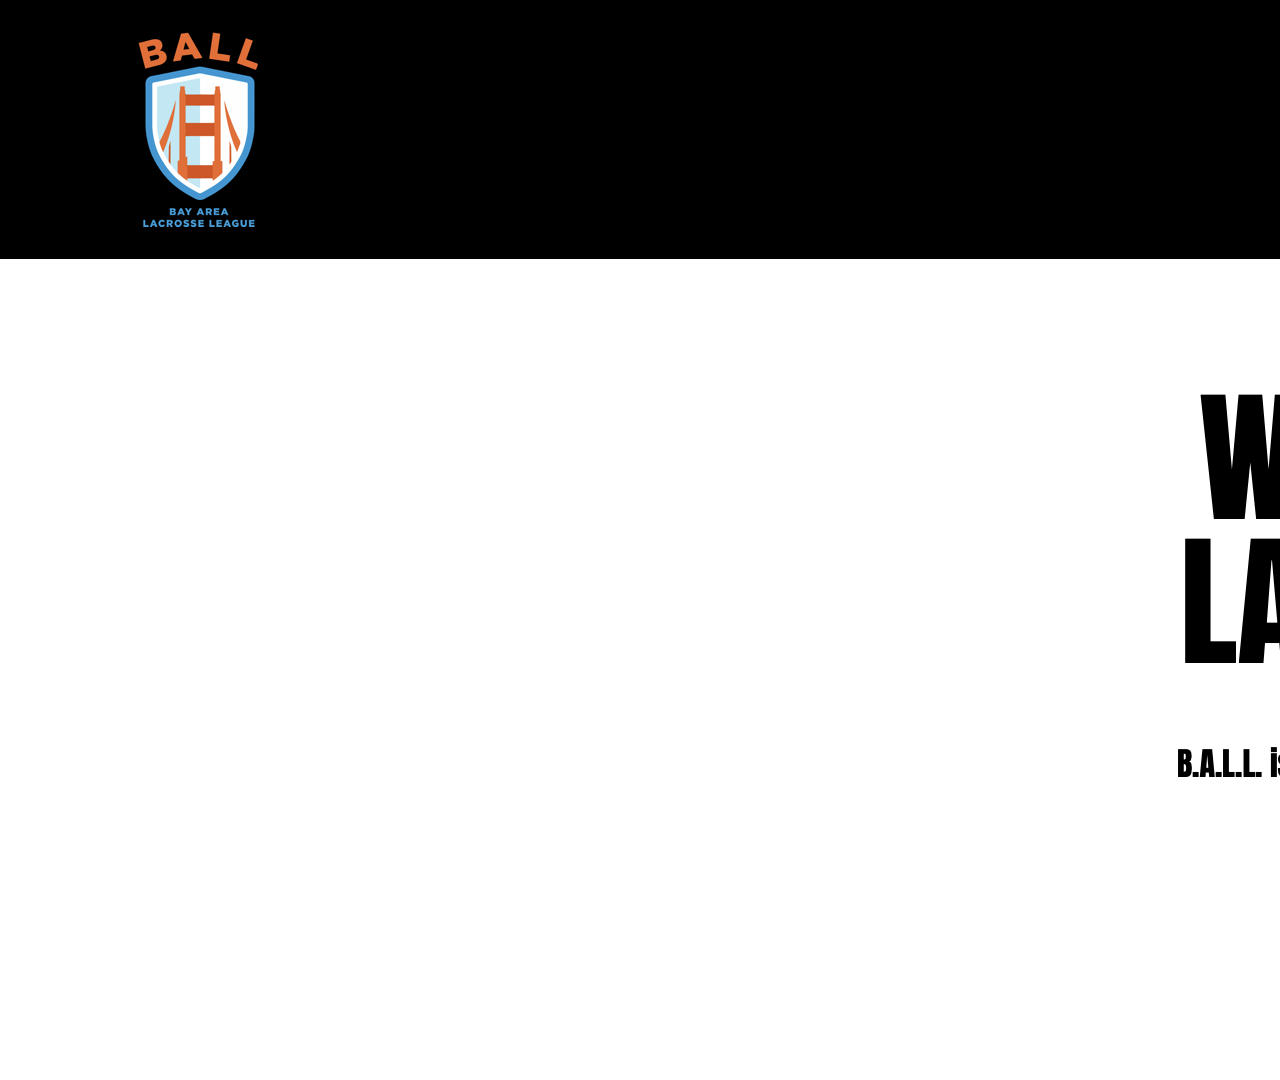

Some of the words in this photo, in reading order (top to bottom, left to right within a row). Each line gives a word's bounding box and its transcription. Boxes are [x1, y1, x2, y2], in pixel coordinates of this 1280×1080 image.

[138, 32, 259, 70] BALL
[169, 207, 192, 216] BAY
[196, 207, 229, 216] AREA
[142, 219, 205, 228] LACROSSE
[208, 219, 256, 228] LEAGUE
[1178, 749, 1262, 777] B.A.L.L.
